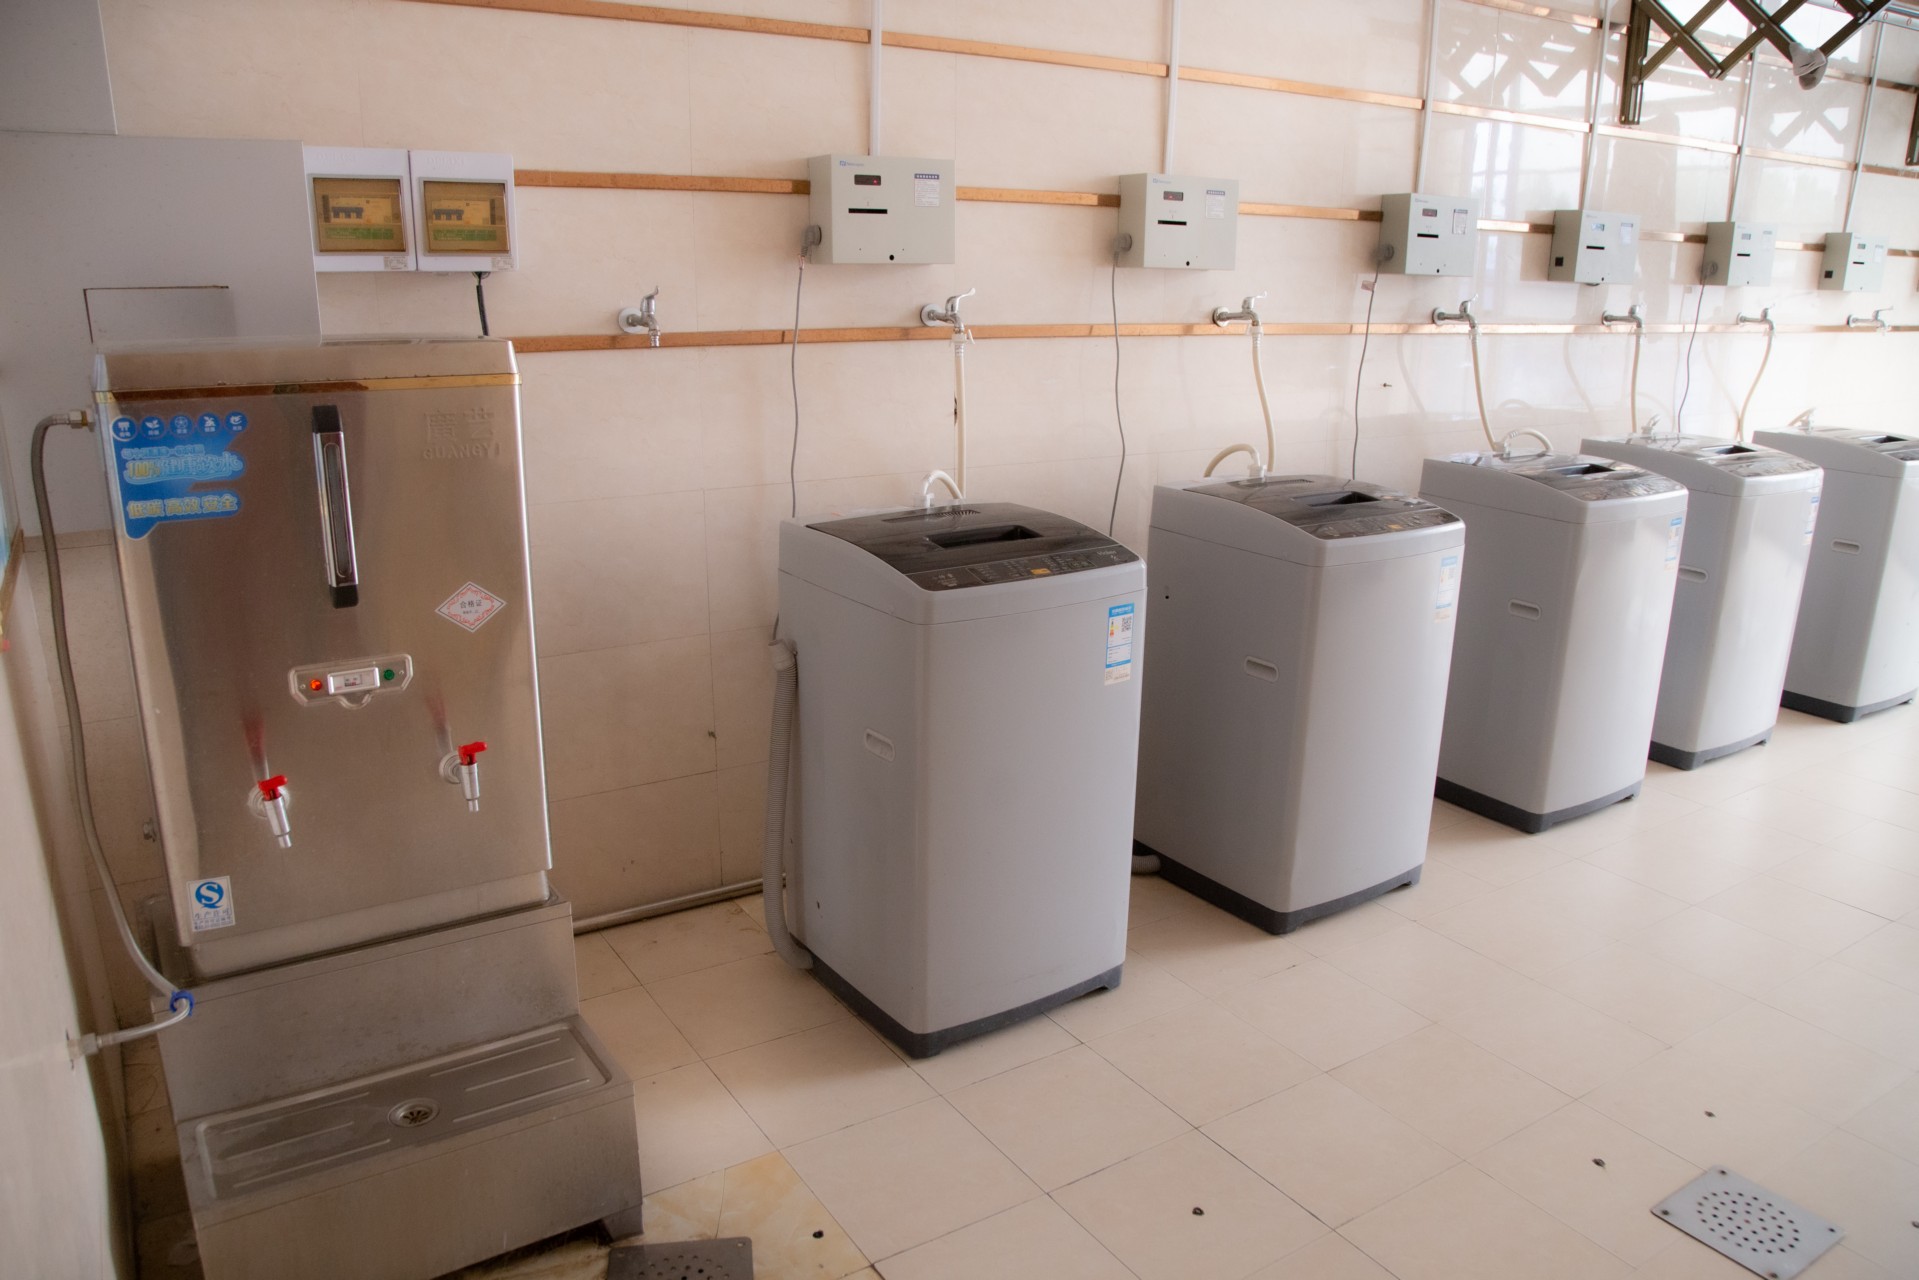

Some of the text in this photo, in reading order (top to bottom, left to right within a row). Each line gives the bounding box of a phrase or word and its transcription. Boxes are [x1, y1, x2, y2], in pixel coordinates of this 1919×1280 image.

[422, 440, 502, 459] GUANGYI
[127, 493, 237, 519] 低碳 高效 安全
